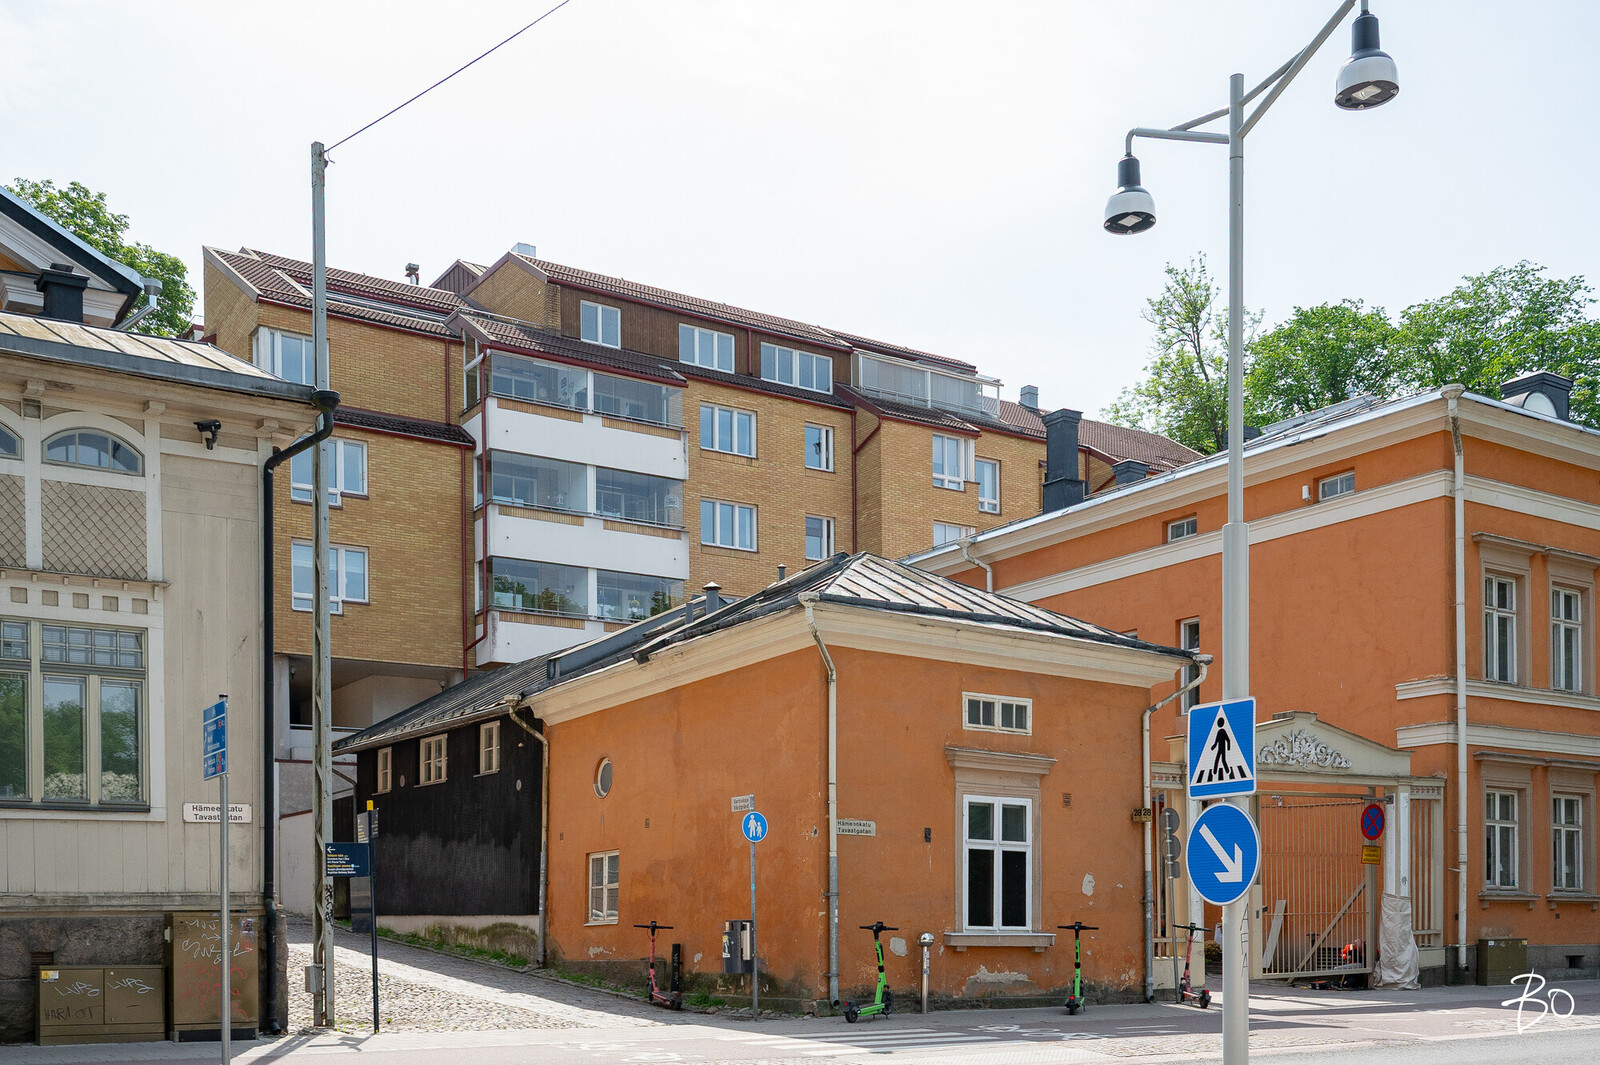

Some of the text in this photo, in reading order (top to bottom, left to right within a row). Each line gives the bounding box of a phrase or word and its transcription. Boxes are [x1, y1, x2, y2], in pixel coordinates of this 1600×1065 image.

[1143, 808, 1151, 816] 28
[837, 820, 872, 828] Hämeenkatu
[838, 827, 872, 835] Tavastgatan
